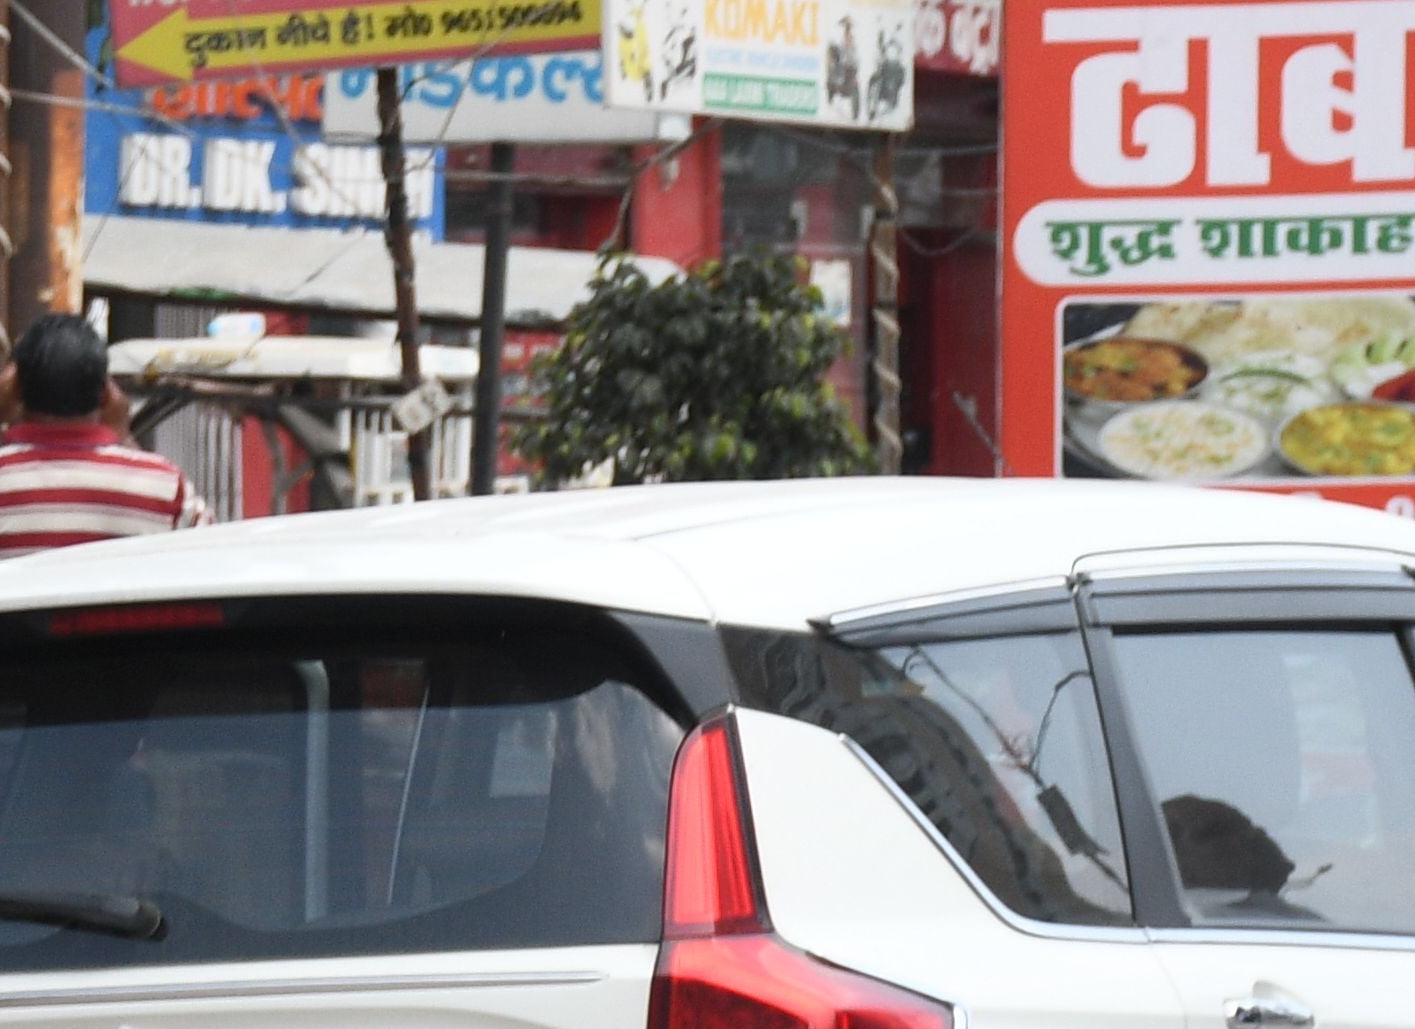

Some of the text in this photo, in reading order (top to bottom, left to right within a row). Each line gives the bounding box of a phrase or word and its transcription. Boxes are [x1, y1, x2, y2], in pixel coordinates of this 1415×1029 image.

[704, 0, 819, 46] KOMAKI
[290, 141, 434, 219] SINH
[1046, 218, 1183, 276] शुद्ध
